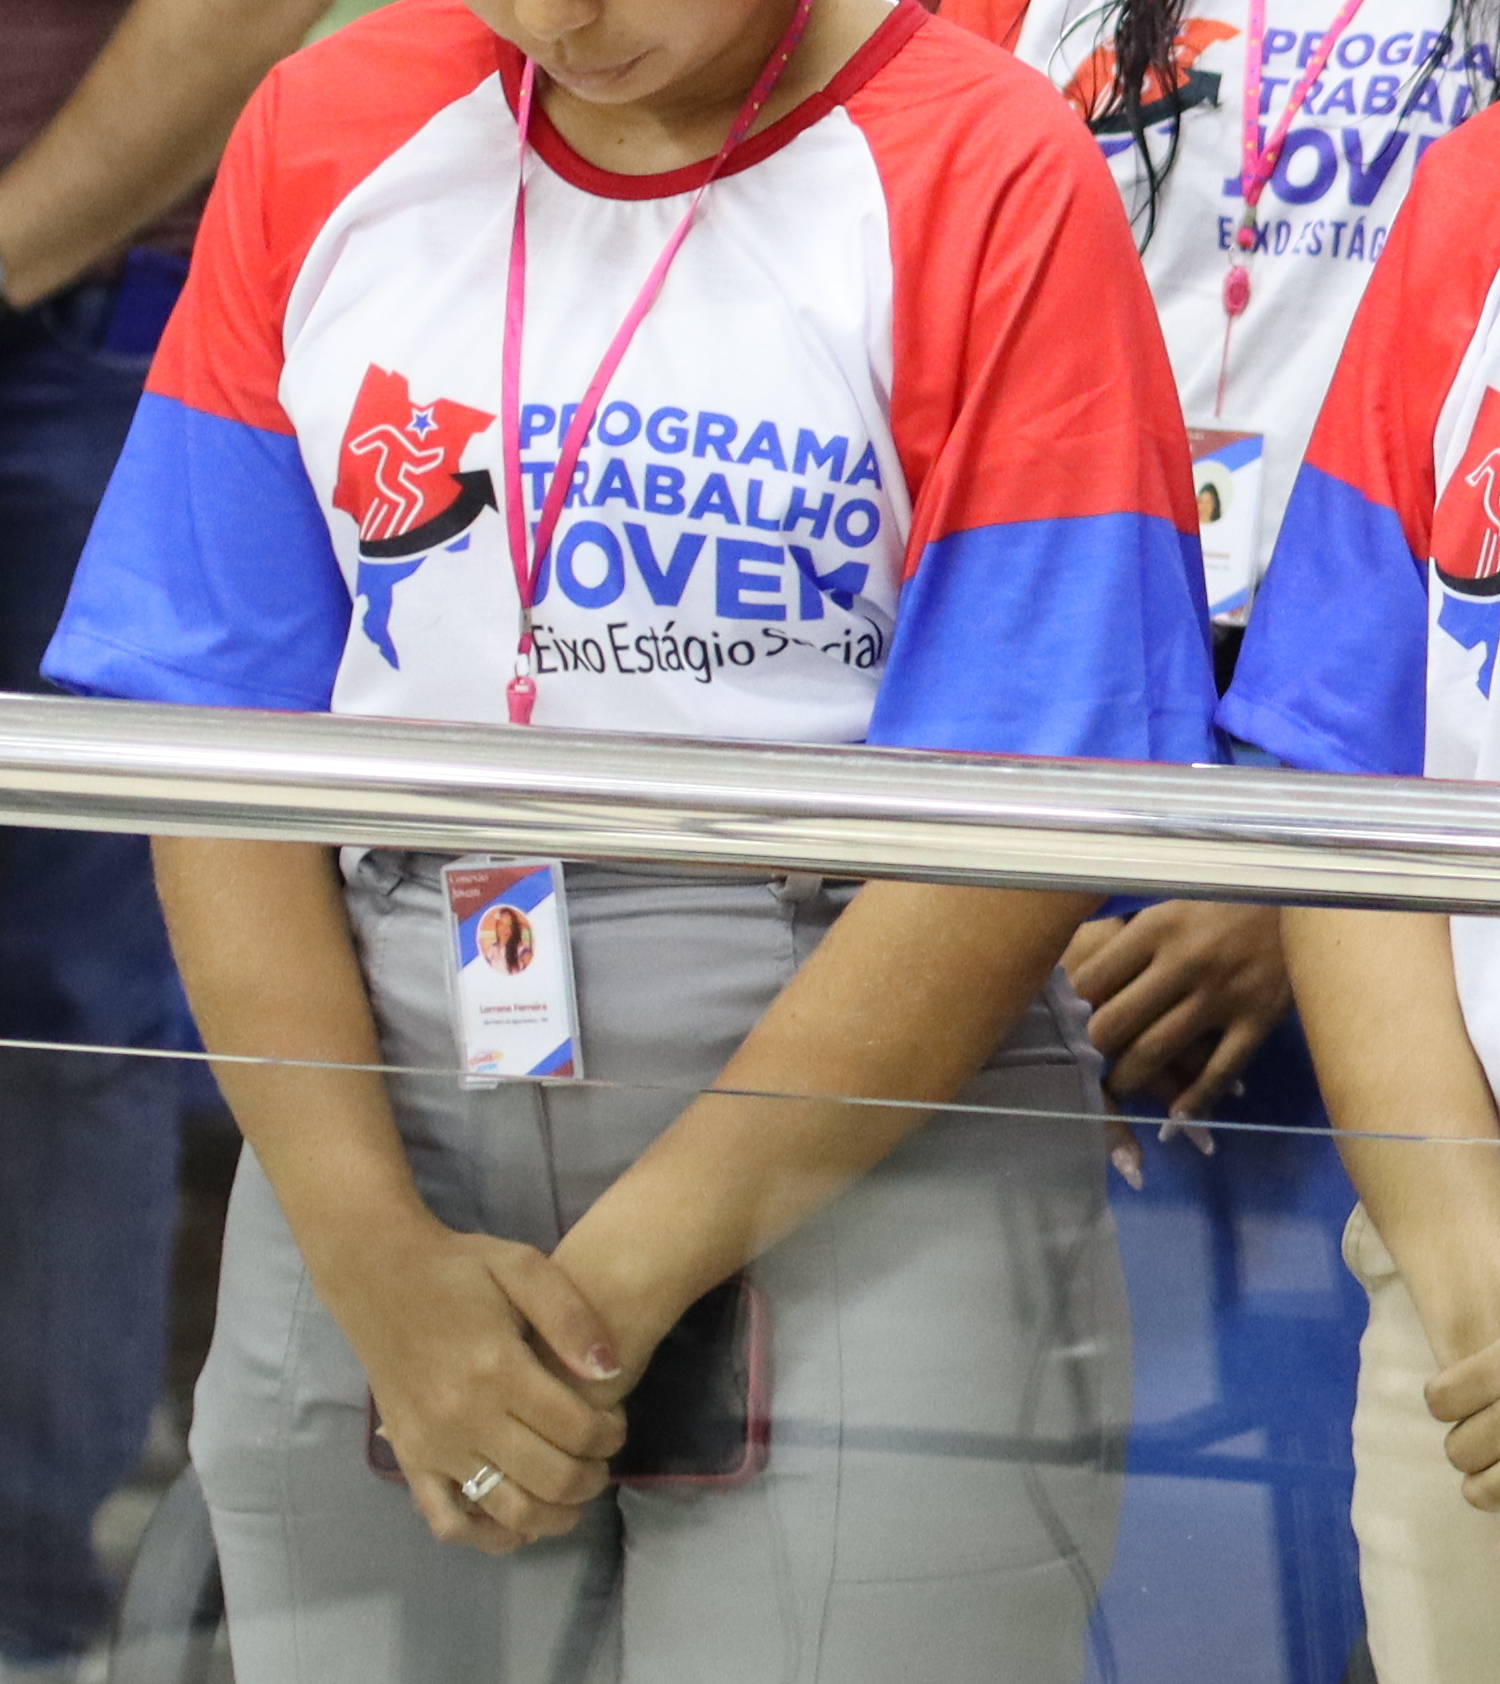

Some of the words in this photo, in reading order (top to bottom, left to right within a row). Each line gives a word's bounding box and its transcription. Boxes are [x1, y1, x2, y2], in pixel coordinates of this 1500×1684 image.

[520, 457, 881, 548] TRABALHO
[531, 624, 604, 675] Eixo
[606, 620, 756, 684] Estágio
